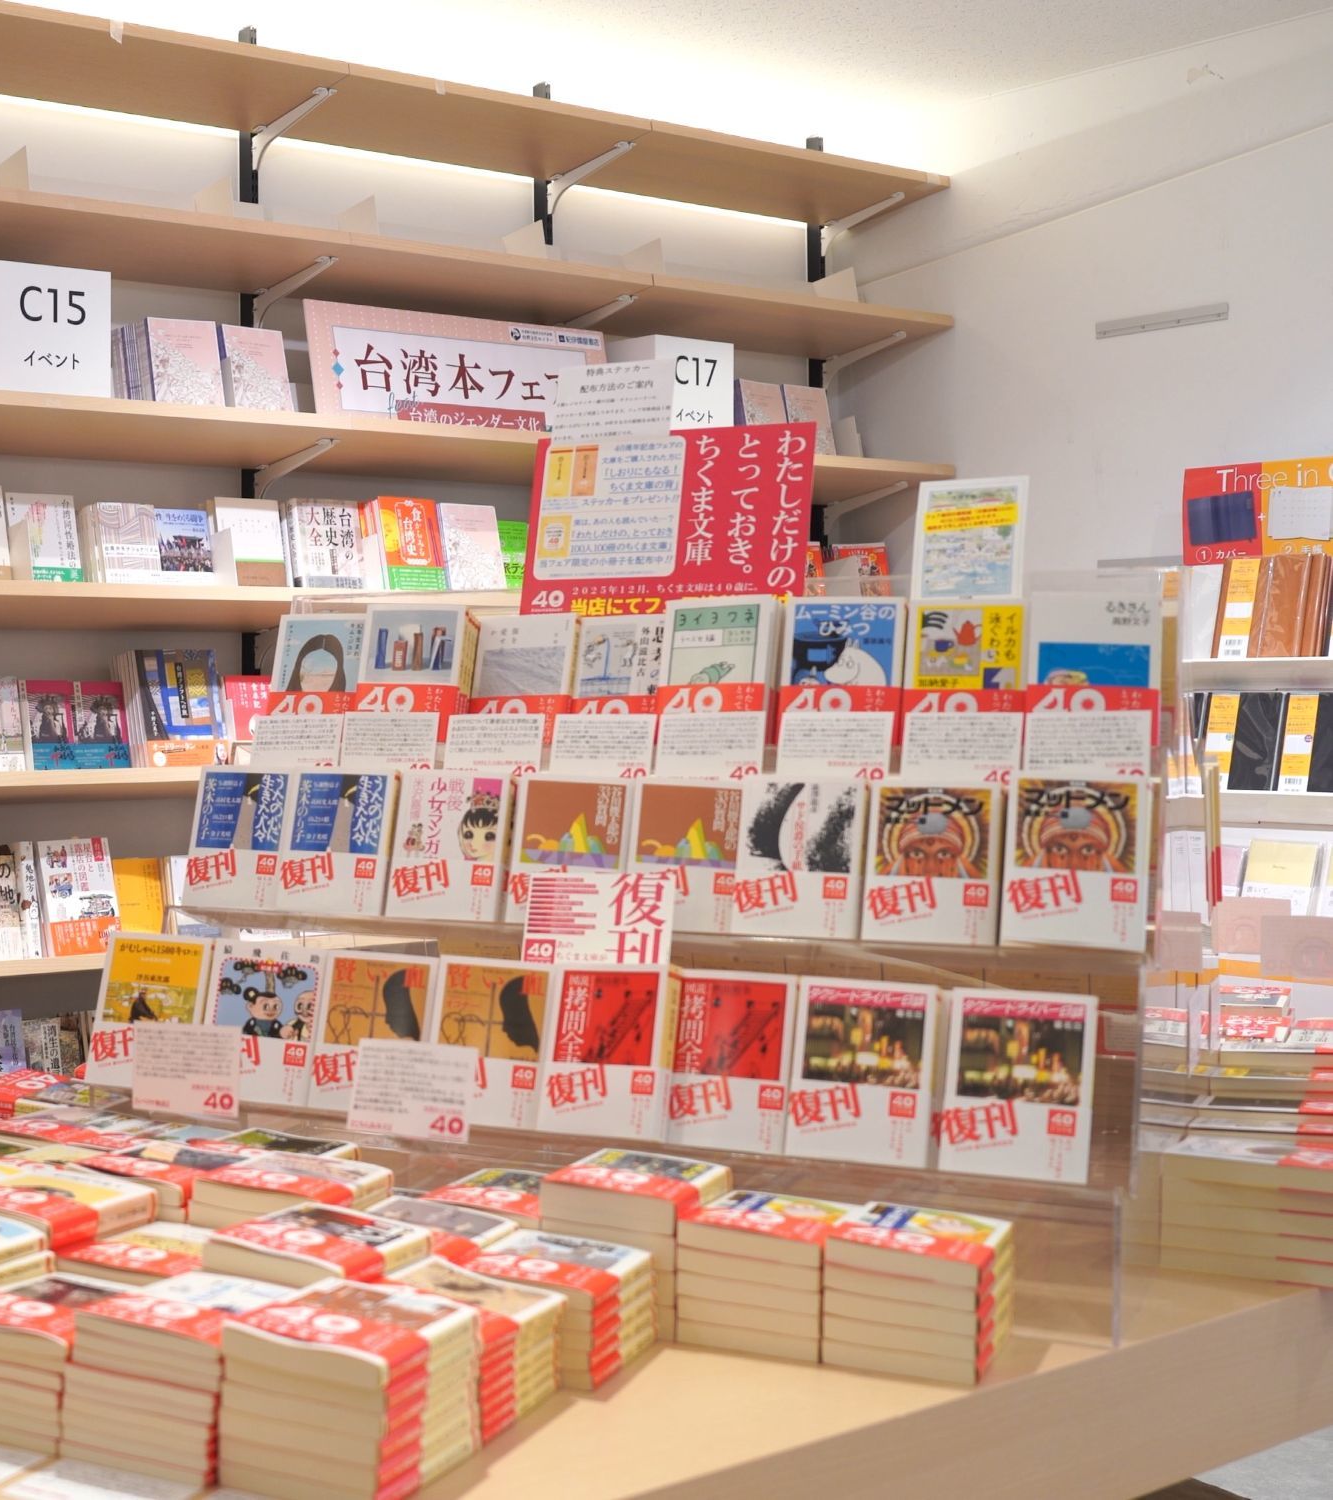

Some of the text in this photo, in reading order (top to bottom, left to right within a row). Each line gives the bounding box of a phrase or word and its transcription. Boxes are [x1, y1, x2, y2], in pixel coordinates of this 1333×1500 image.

[19, 285, 87, 325] C15
[23, 351, 81, 371] イベント
[586, 363, 651, 377] 特典ステッカー
[674, 355, 718, 388] C17
[579, 380, 654, 394] 配布方法のご案内
[675, 408, 714, 424] イベント
[1216, 463, 1319, 492] Three in
[684, 434, 721, 566] ちくま文庫
[727, 433, 762, 575] とっておき。
[307, 507, 324, 547] 大全
[322, 507, 338, 547] 歴史
[340, 508, 355, 562] 台湾の
[402, 517, 416, 557] 台湾史
[1216, 550, 1247, 561] カバー
[531, 590, 565, 607] 40
[1106, 602, 1150, 615] るきさん
[677, 609, 756, 627] ヨイヨワネ
[794, 604, 896, 621] ムーミン谷の
[1112, 616, 1151, 627] 高野文子
[818, 620, 871, 636] ひみつ
[1004, 612, 1017, 663] イルカも
[636, 626, 651, 678] 外山滋比古
[270, 695, 323, 715] 40
[357, 686, 415, 712] 40
[665, 687, 723, 713] 40
[786, 688, 852, 712] 40
[911, 692, 979, 713] 40
[1032, 687, 1106, 711] 40
[448, 778, 465, 812] 戦後
[200, 778, 219, 840] 茨木のり子
[254, 774, 272, 844] 生きた人々
[266, 774, 284, 844] うたの心に
[295, 779, 316, 843] 茨木のり子
[352, 776, 370, 846] 生きた人々
[366, 776, 384, 847] うたの心に
[187, 848, 237, 886] 復刊
[260, 857, 275, 866] 40
[280, 850, 335, 890] 復刊
[357, 861, 374, 871] 40
[474, 867, 493, 877] 40
[25, 863, 34, 891] 鬼地方
[392, 859, 450, 898] 復刊
[826, 880, 844, 890] 40
[1114, 882, 1136, 893] 40
[0, 886, 15, 905] 地
[734, 869, 799, 913] 復刊
[869, 875, 938, 919] 復刊
[966, 886, 987, 897] 40
[1008, 868, 1083, 912] 復刊
[606, 872, 667, 965] 復刊
[526, 943, 554, 957] 40
[335, 957, 425, 989] 賢い血
[448, 963, 545, 996] 賢い血
[568, 975, 589, 986] 図説
[684, 982, 707, 995] 図説
[809, 987, 927, 1007] タクシードライバー日誌
[963, 1000, 1086, 1020] タクシードライバー日誌
[287, 1047, 306, 1057] 40
[514, 1068, 534, 1079] 40
[546, 1063, 608, 1108] 復刊
[632, 1074, 653, 1085] 40
[204, 1093, 234, 1111] 40
[670, 1072, 733, 1120] 復刊
[761, 1088, 782, 1099] 40
[788, 1083, 862, 1128] 復刊
[891, 1093, 914, 1107] 40
[429, 1115, 464, 1135] 40
[938, 1100, 1019, 1146] 復刊
[1050, 1113, 1075, 1126] 40
